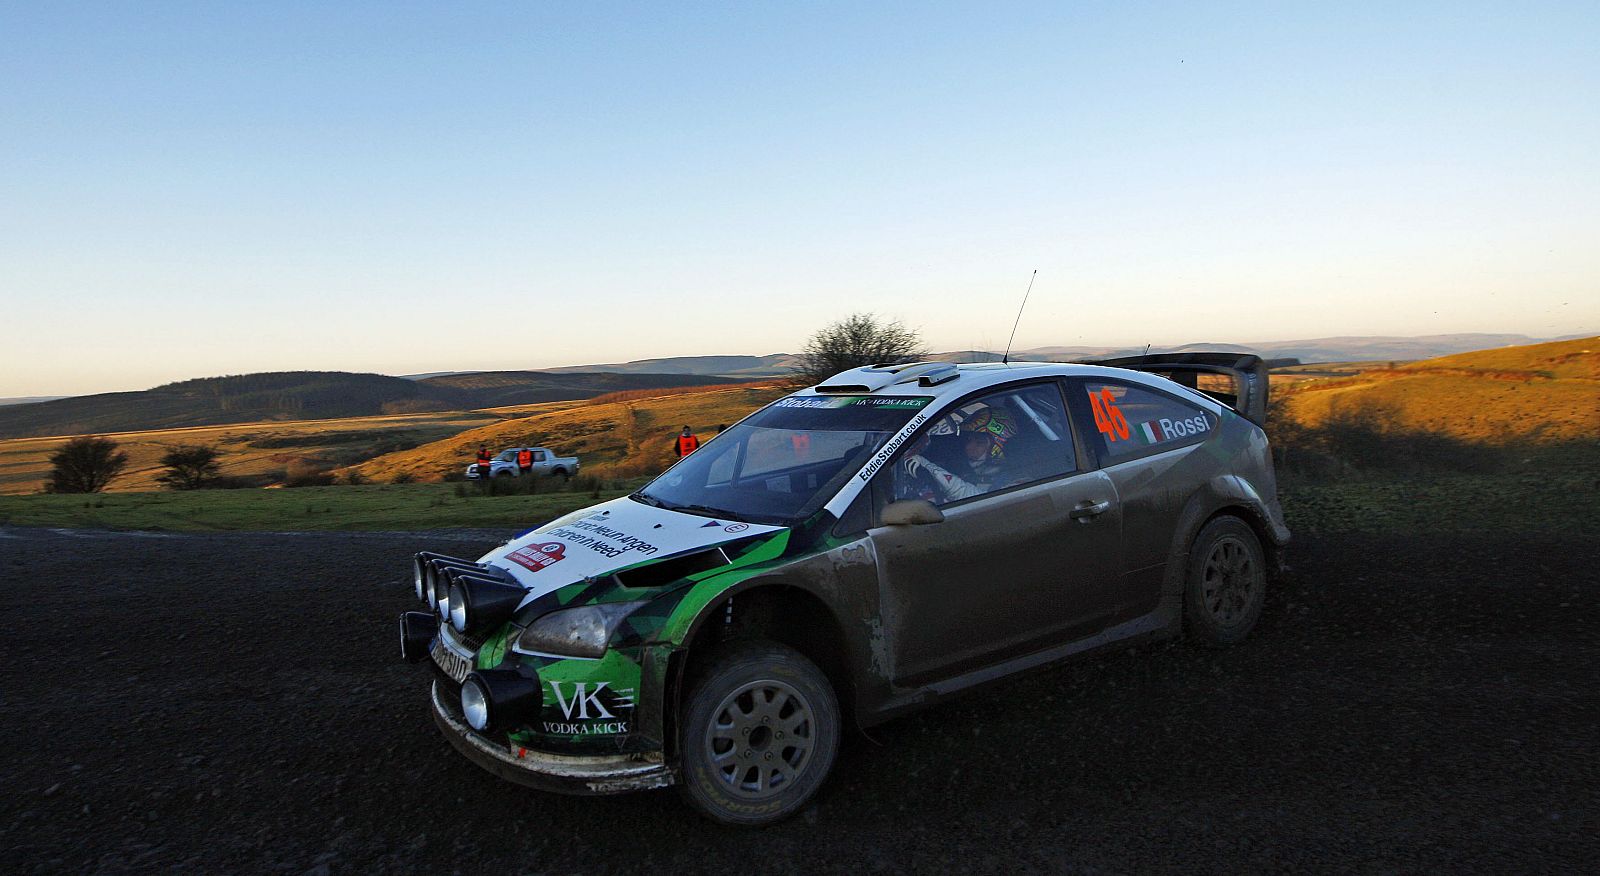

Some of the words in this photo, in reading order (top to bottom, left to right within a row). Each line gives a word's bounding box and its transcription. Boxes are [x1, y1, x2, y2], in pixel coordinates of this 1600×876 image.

[1089, 388, 1130, 442] 46
[1159, 411, 1210, 440] Rossi
[858, 414, 926, 481] EddieStobart.co.uk
[590, 540, 625, 558] Need
[617, 535, 658, 556] Angen
[549, 680, 616, 721] VK
[543, 721, 589, 735] VODKA
[593, 721, 628, 735] KICK
